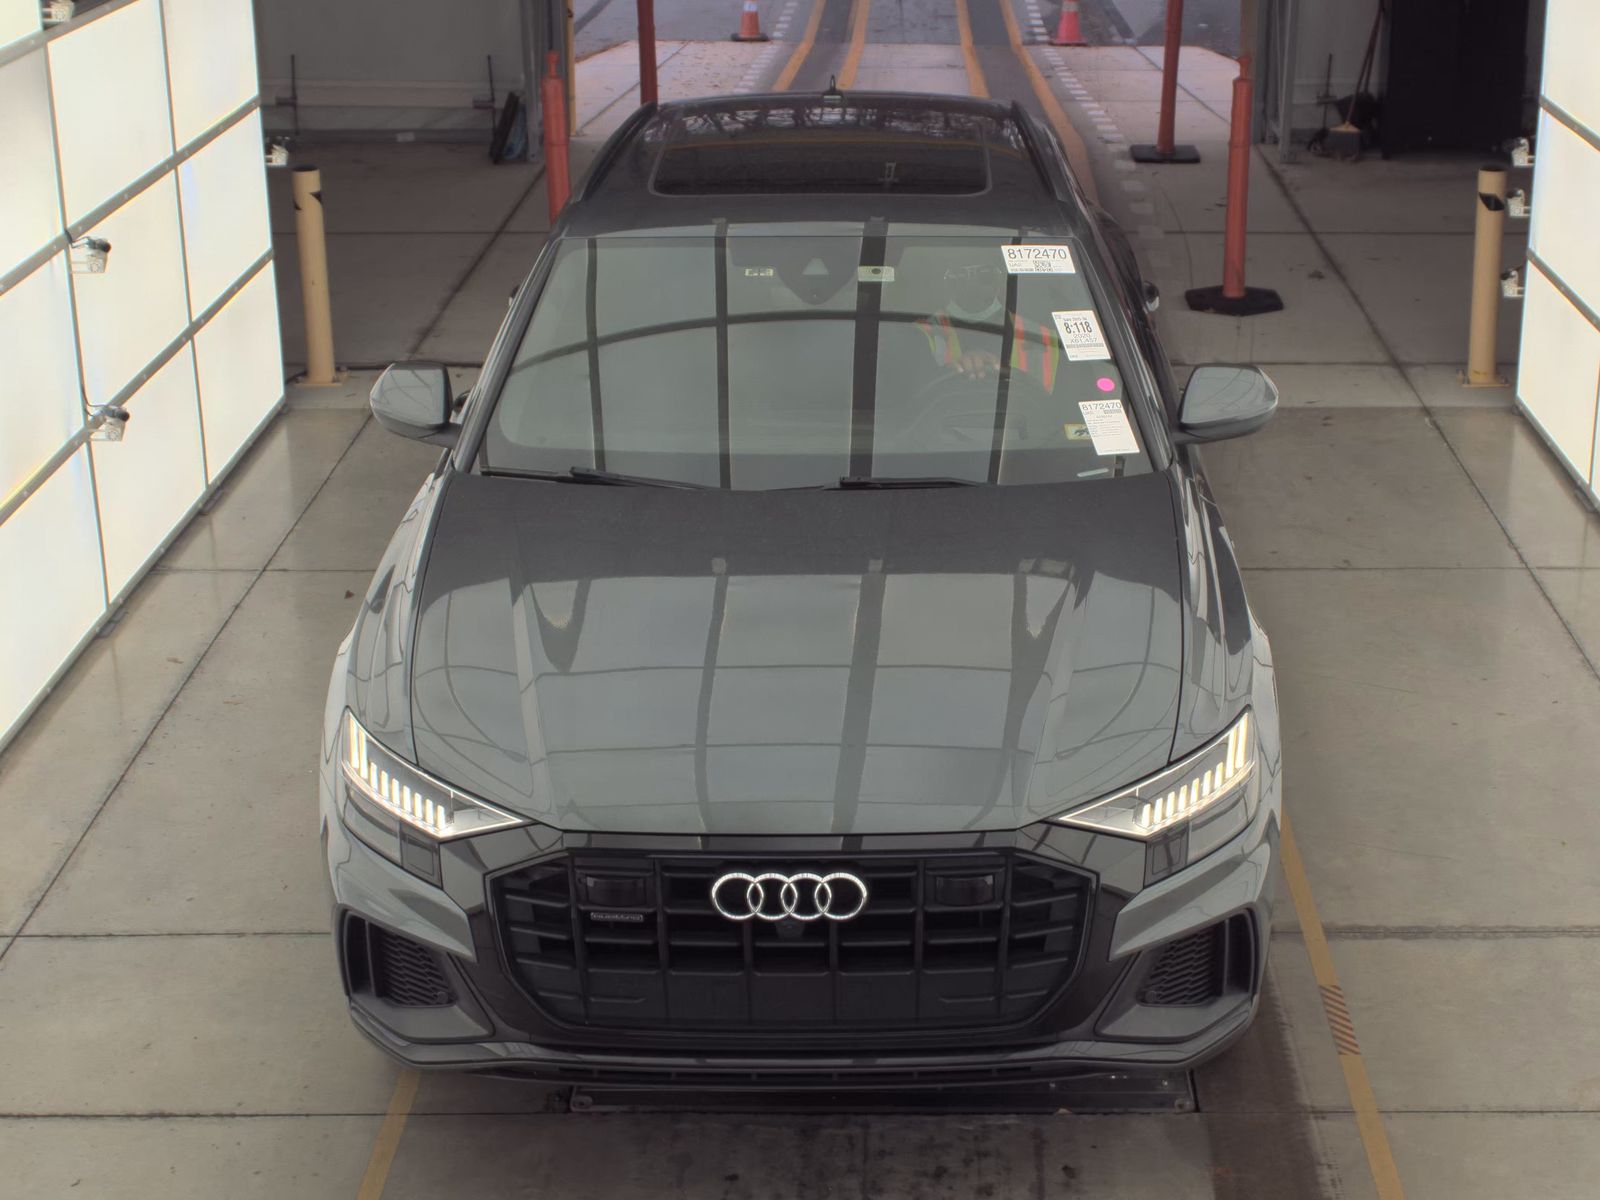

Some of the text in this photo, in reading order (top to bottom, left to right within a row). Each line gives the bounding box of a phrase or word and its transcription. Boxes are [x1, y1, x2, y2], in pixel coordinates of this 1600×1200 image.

[1007, 248, 1067, 260] 8172470
[1064, 321, 1092, 334] 8:118
[1081, 401, 1122, 411] 8172470
